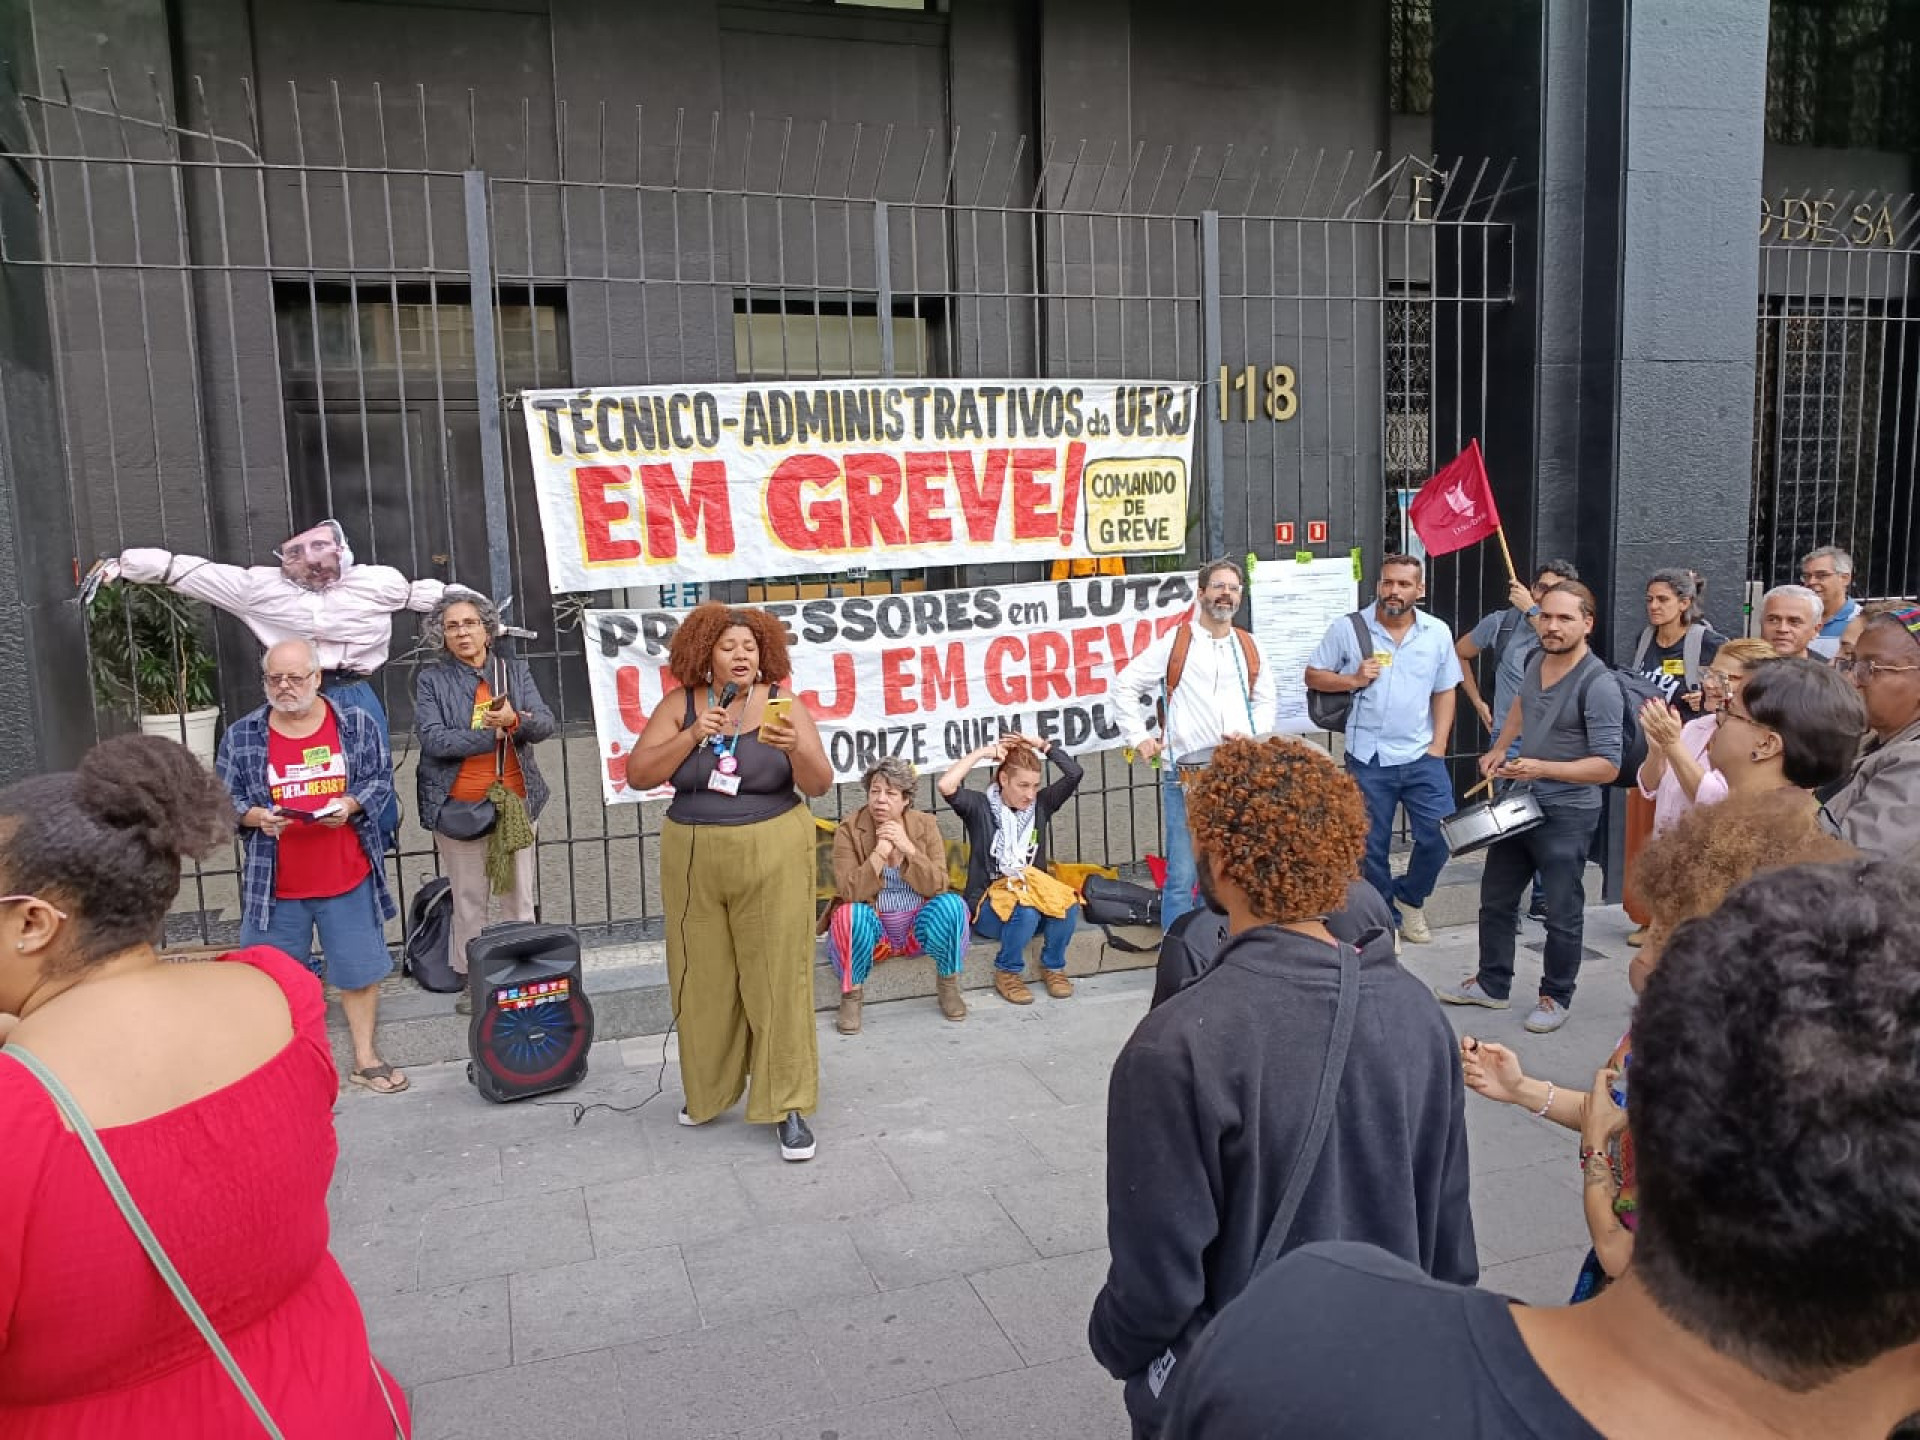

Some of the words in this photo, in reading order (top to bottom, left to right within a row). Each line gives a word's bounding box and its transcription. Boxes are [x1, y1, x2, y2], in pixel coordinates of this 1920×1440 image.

[1780, 199, 1835, 242] DE
[532, 386, 1083, 456] TÉCNICO-ADMINISTRATIVOS
[1087, 408, 1110, 436] da
[1115, 386, 1192, 438] UERJ
[1220, 365, 1297, 421] 118
[575, 459, 735, 563] EM
[765, 441, 1086, 552] GREVE!
[1092, 470, 1176, 498] COMANDO
[1124, 500, 1144, 516] DE
[1100, 518, 1170, 544] GREVE
[599, 587, 1002, 657] PRESSORES
[1008, 600, 1047, 625] em
[1057, 575, 1195, 621] LUTA
[881, 640, 969, 716] EM
[1037, 693, 1157, 754] EDU
